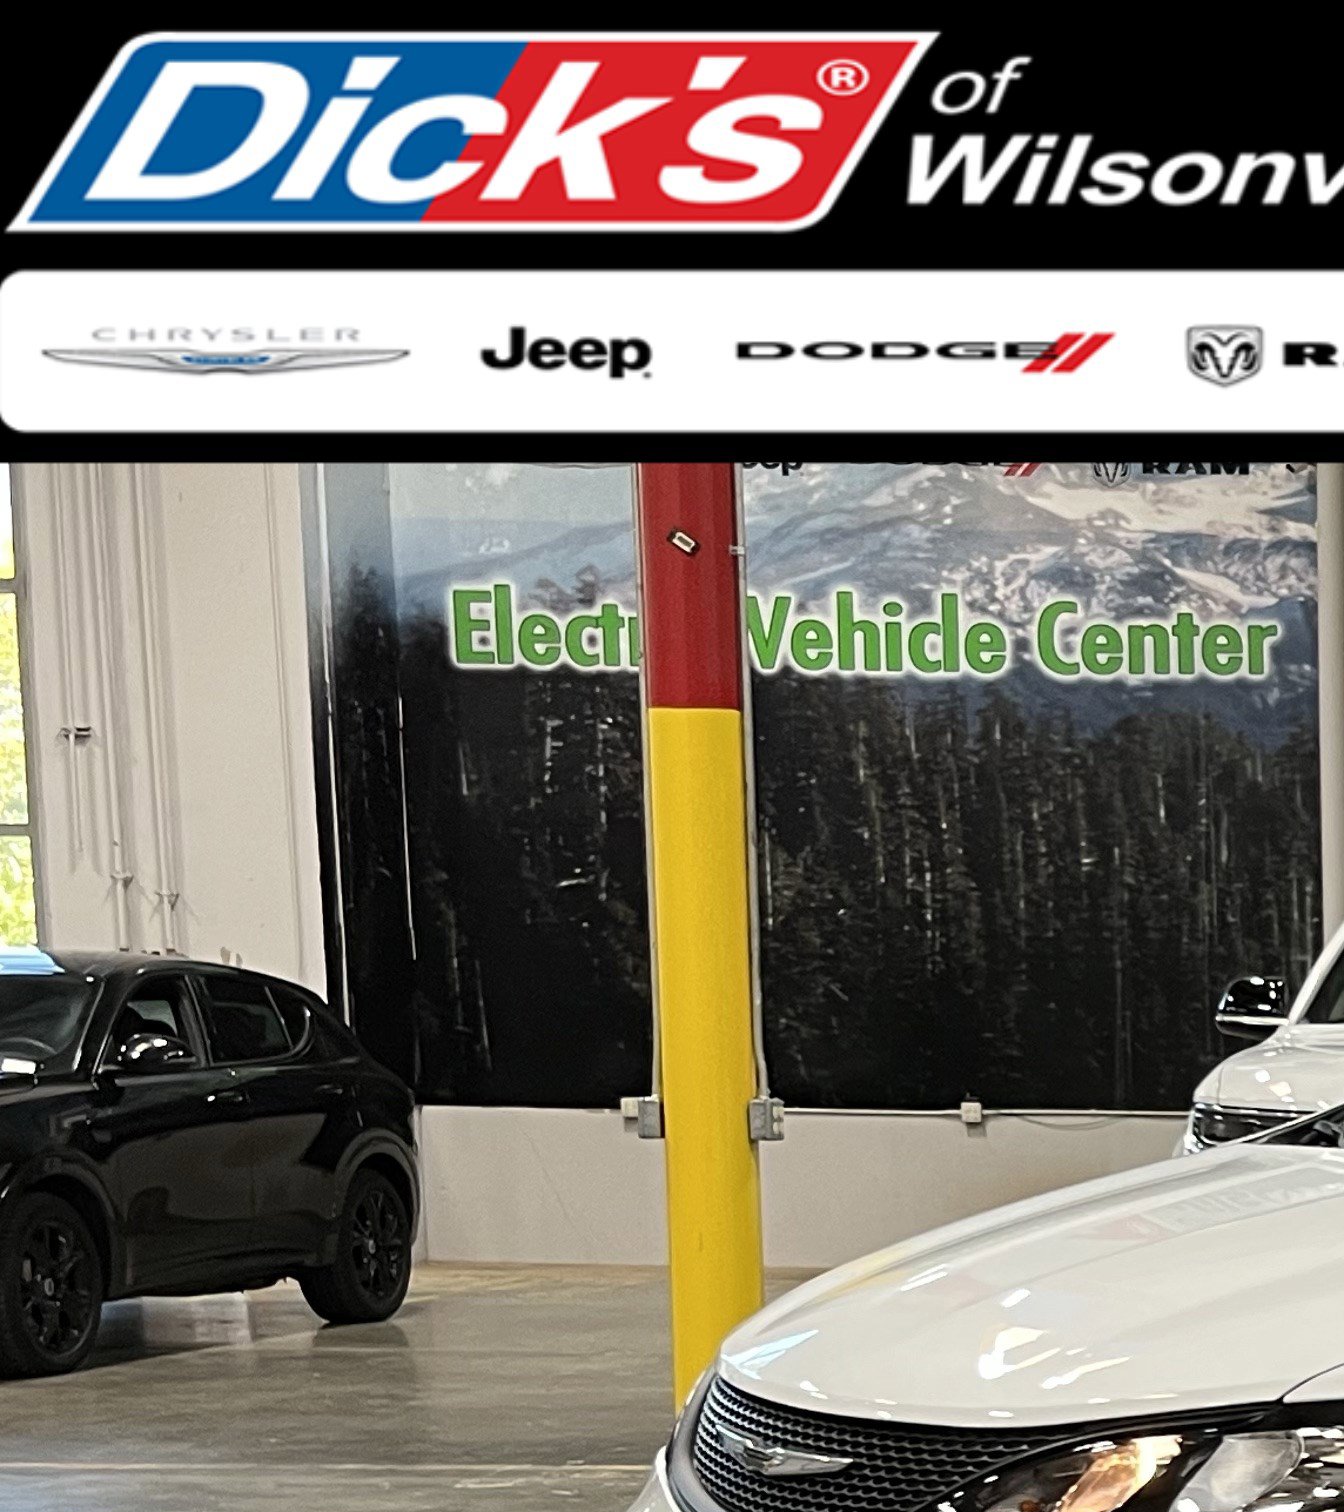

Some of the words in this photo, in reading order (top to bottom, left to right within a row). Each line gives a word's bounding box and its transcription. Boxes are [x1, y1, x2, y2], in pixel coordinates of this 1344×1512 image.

[453, 584, 639, 666] Elect
[747, 590, 1007, 673] Vehicle
[1038, 601, 1278, 676] Center
